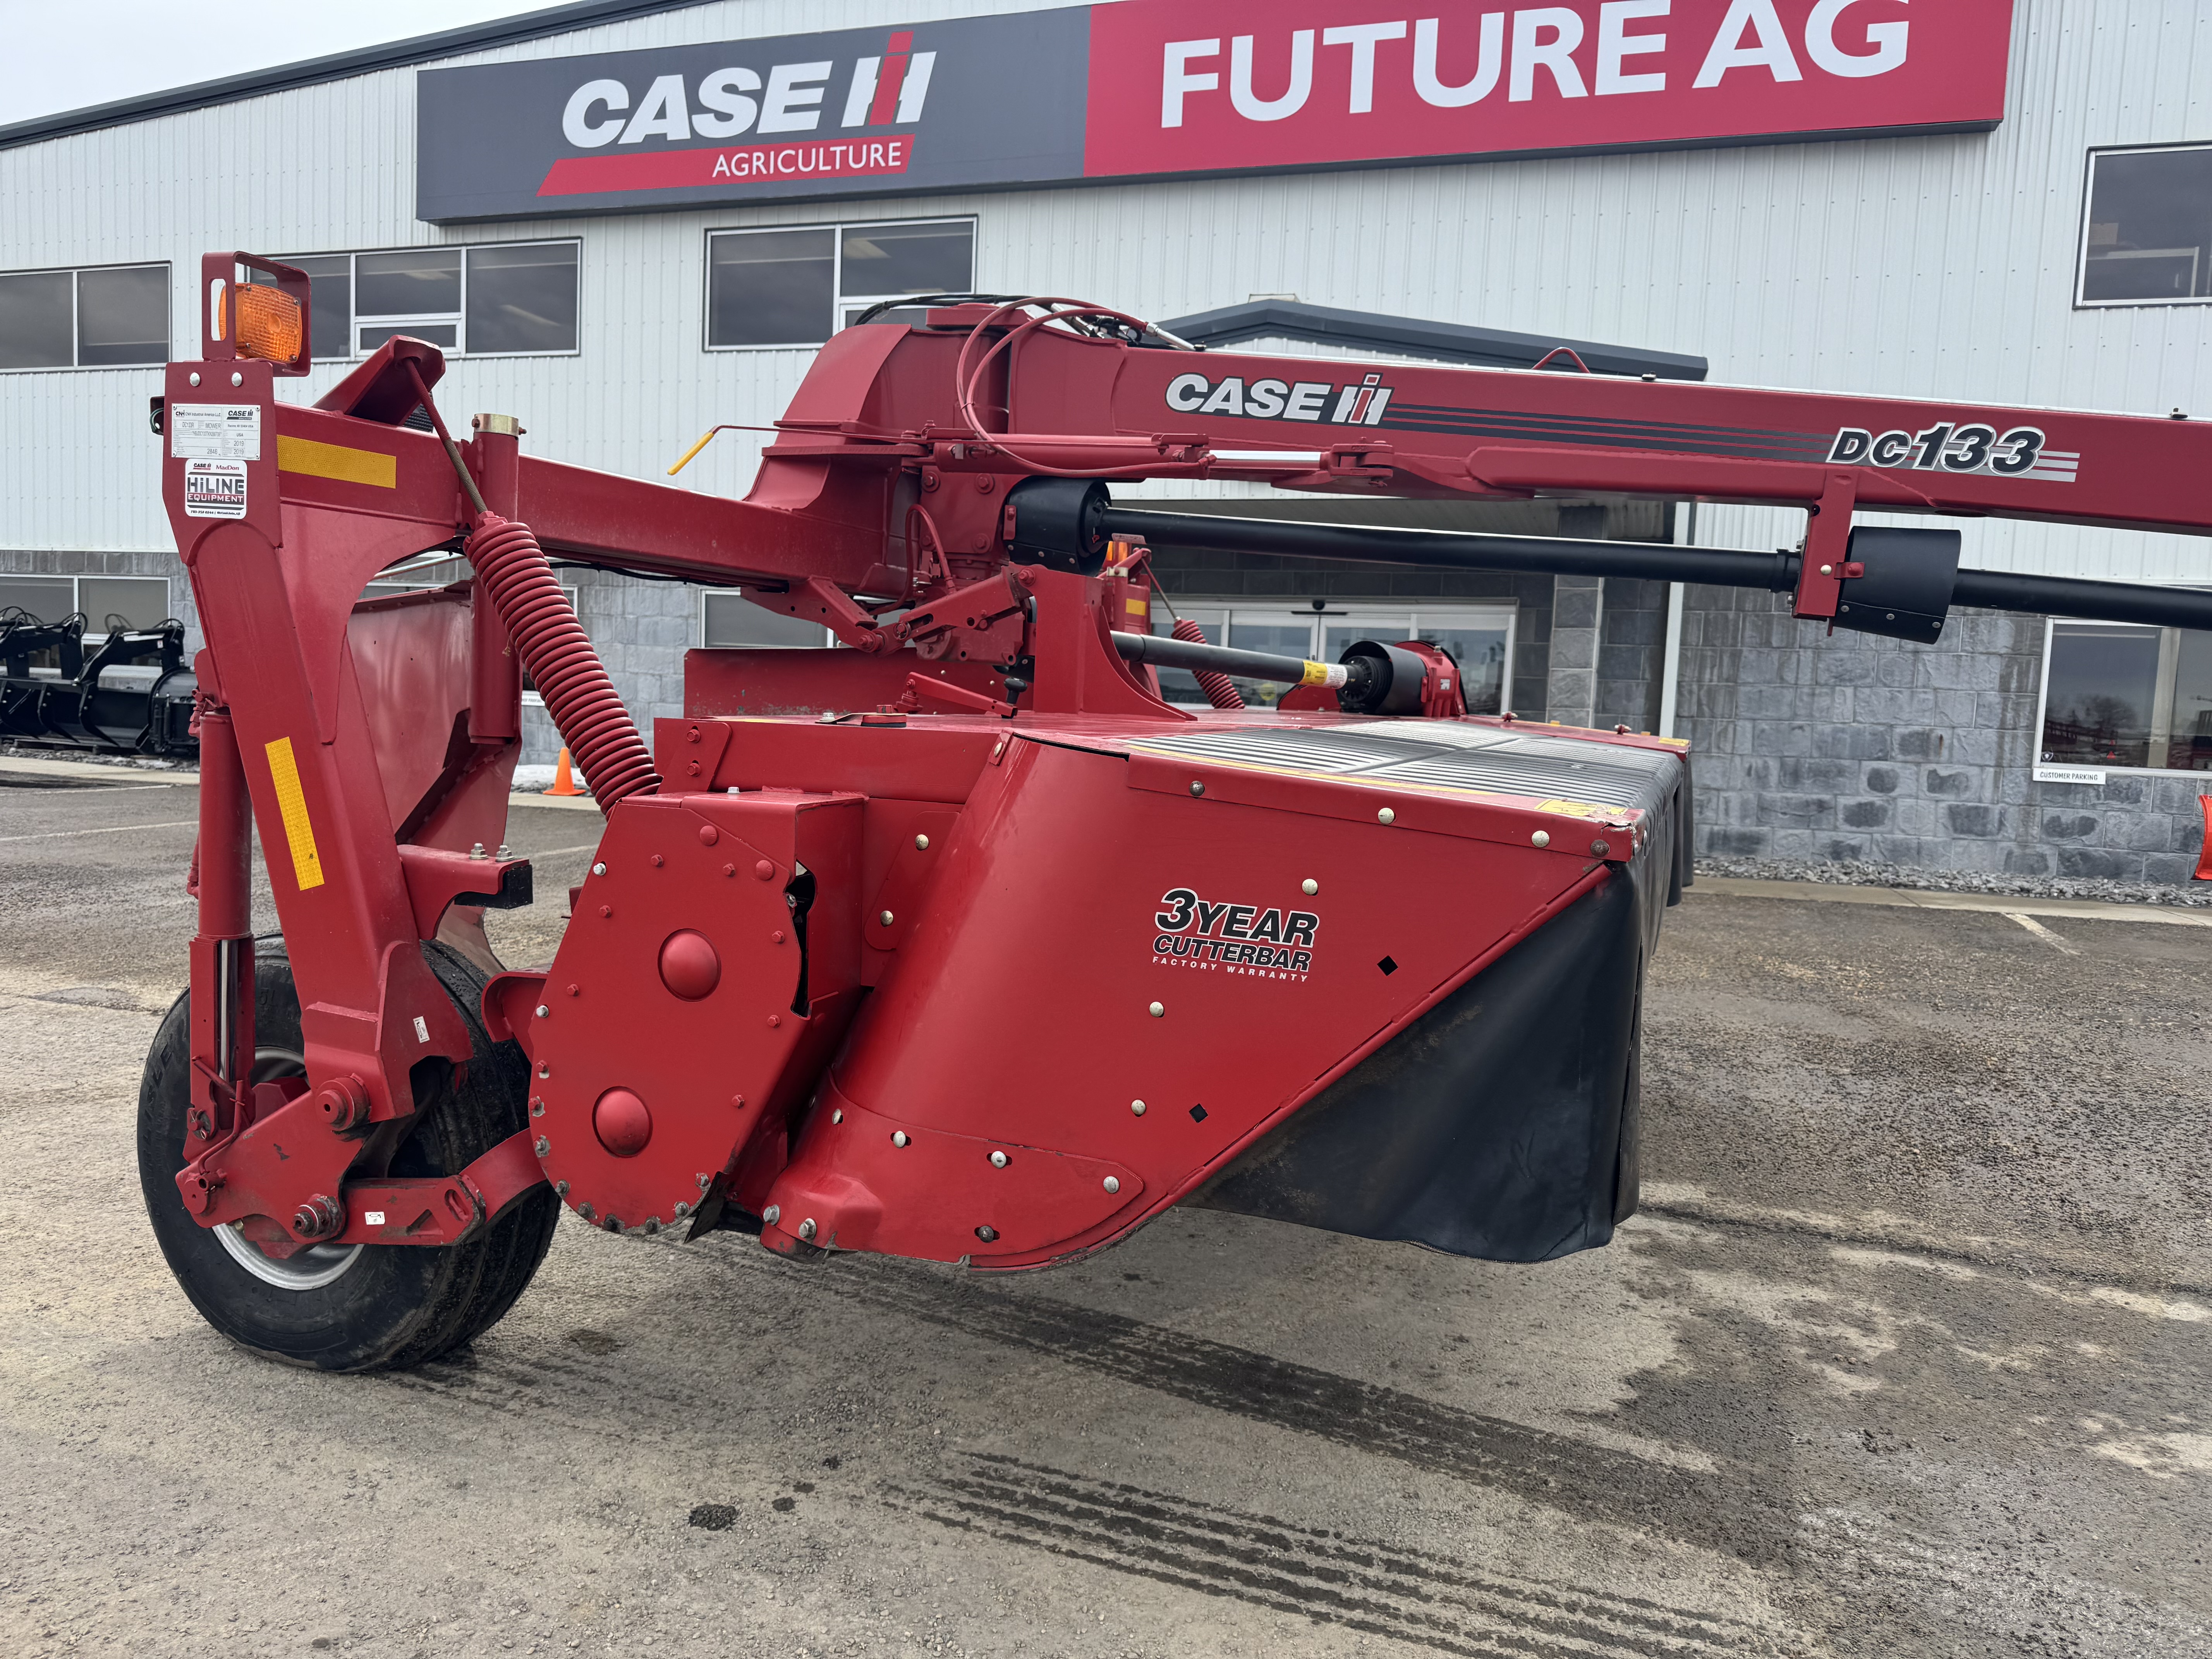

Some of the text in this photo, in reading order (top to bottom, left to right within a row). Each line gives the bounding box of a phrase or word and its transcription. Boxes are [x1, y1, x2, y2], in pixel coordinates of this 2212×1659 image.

[1162, 0, 1909, 127] FUTURE AG
[563, 61, 833, 148] CASE
[712, 142, 902, 178] AGRICULTURE
[1165, 373, 1331, 421] CASE
[1826, 422, 2046, 477] DC133
[187, 477, 244, 495] HiLINE
[188, 494, 243, 502] EQUIPMENT
[1152, 957, 1308, 982] FACTORY WARRANTY
[1153, 934, 1312, 972] CUTTERBAR
